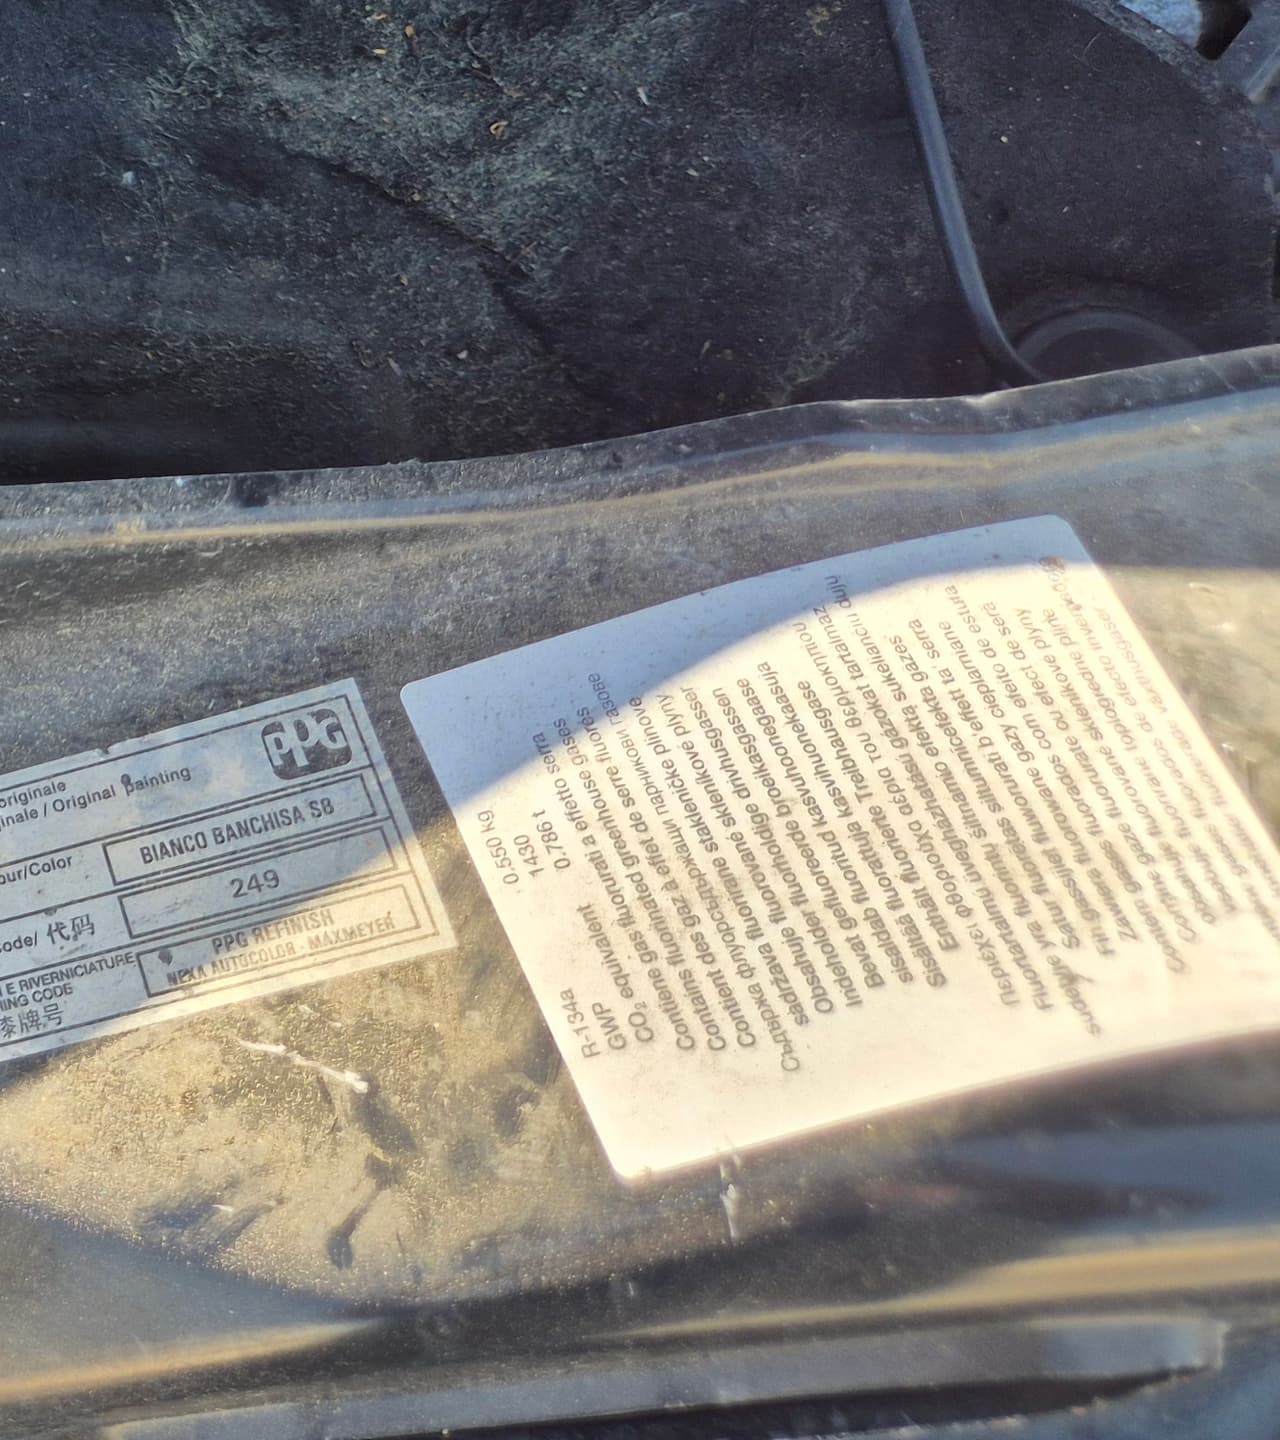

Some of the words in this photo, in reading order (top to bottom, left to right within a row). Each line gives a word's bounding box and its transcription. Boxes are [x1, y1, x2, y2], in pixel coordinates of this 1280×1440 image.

[807, 604, 867, 680] tartalmaz
[972, 637, 998, 659] de
[1001, 639, 1028, 661] de
[585, 672, 624, 725] газове
[987, 662, 1030, 709] efeito
[260, 705, 351, 772] PPG
[551, 716, 589, 766] gases
[571, 705, 614, 762] fluorés
[623, 695, 671, 755] plinove
[651, 692, 690, 737] plyny
[676, 684, 756, 801] drivhusgasser
[751, 660, 858, 818] kasvihuonekaasuja
[790, 678, 880, 802] Treibhausgase
[852, 682, 910, 750] gázokat
[996, 721, 1037, 763] gazy
[1019, 712, 1054, 750] com
[529, 731, 561, 774] serra
[613, 727, 671, 815] парникови
[707, 686, 796, 817] broeikasgassen
[731, 676, 833, 827] kasvuhoonegaase
[854, 731, 884, 763] του
[50, 783, 117, 815] Original
[121, 762, 192, 797] painting
[549, 777, 589, 832] effetto
[603, 764, 637, 808] serre
[655, 758, 720, 853] stakleničke
[138, 830, 208, 864] BIANCO
[210, 805, 305, 845] BANCHISA
[472, 809, 499, 832] kg
[534, 820, 572, 870] 0.786
[573, 768, 640, 869] greenhouse
[624, 810, 650, 834] de
[859, 804, 922, 884] fluorierte
[483, 836, 521, 885] 0.550
[511, 833, 546, 877] 1430
[636, 836, 671, 877] effet
[723, 830, 788, 924] fluorované
[739, 801, 815, 906] fluorholdige
[778, 818, 859, 931] gefluoreerde
[815, 829, 871, 904] fluoritud
[839, 820, 910, 911] fluorattuja
[227, 867, 282, 899] 249
[584, 849, 637, 928] fluorurati
[668, 892, 702, 928] gaz
[707, 856, 766, 940] fluorirane
[43, 912, 97, 947] 代码
[210, 930, 249, 955] PPG
[250, 908, 335, 944] REFINISH
[624, 870, 686, 966] fluorinated
[626, 928, 659, 964] gas
[857, 906, 916, 984] sisaldab
[906, 885, 961, 951] Enthält
[1025, 919, 1056, 949] yra
[1036, 898, 1084, 950] Satur
[5, 982, 16, 995] E
[18, 951, 134, 992] RIVERNICIATURE
[165, 964, 207, 986] NEXA
[209, 940, 296, 974] AUTOCOLOR
[574, 902, 639, 1000] equivalent
[685, 931, 717, 965] des
[773, 925, 839, 1014] Obsahuje
[796, 908, 865, 1007] Indeholder
[840, 934, 887, 989] Bevat
[30, 982, 73, 1003] CODE
[642, 967, 698, 1051] Contiene
[672, 968, 729, 1052] Contains
[702, 967, 759, 1048] Contient
[554, 988, 601, 1058] R-134a
[590, 1000, 628, 1050] GWP
[741, 982, 805, 1072] Съдържа
